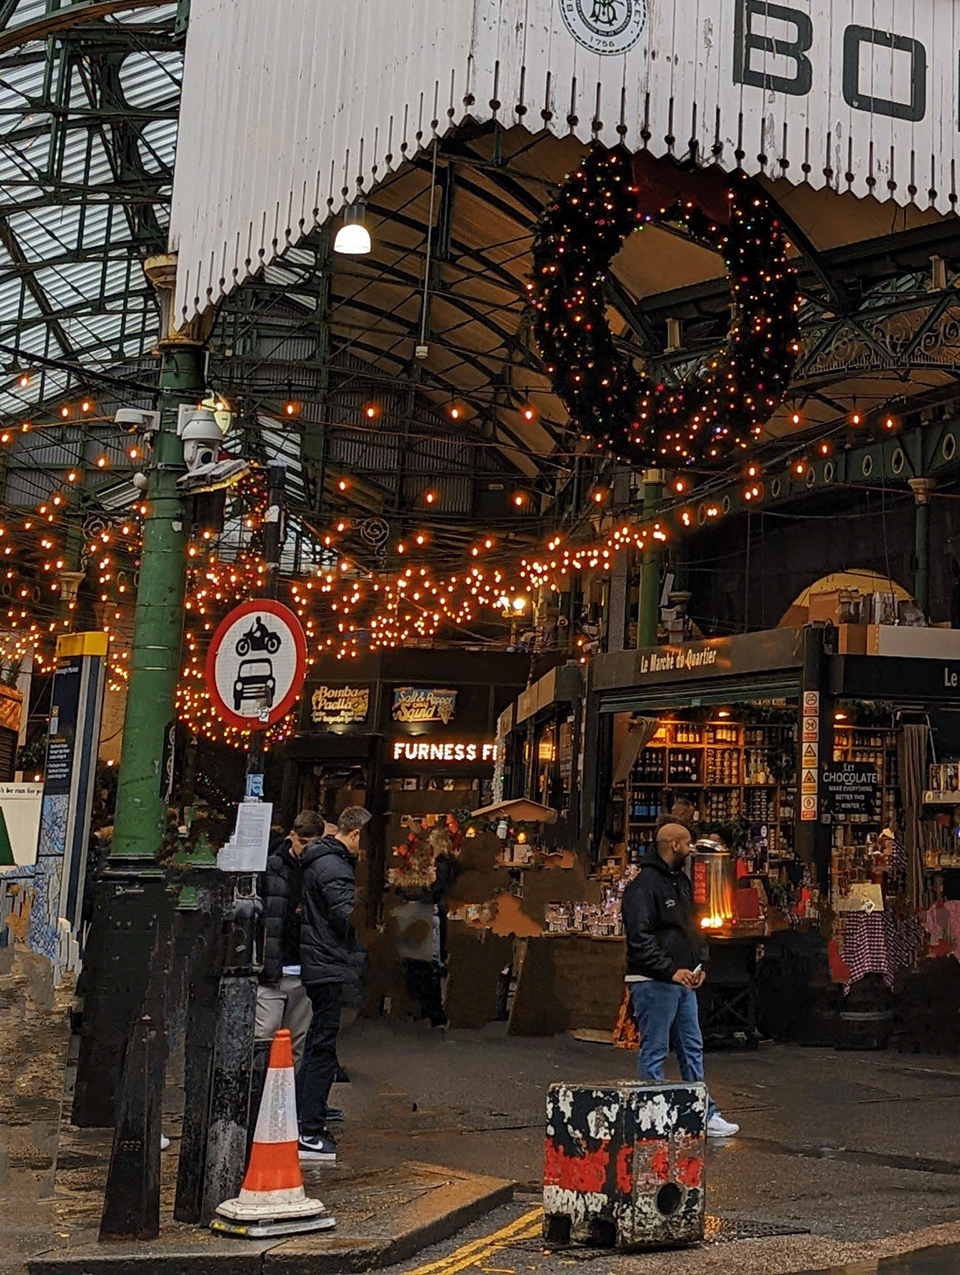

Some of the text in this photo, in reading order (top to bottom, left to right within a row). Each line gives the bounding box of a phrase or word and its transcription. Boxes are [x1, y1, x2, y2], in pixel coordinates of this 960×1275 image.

[590, 36, 615, 47] 1756
[640, 646, 717, 674] Le Marché du Quartier
[944, 668, 958, 687] Le
[394, 743, 477, 761] FURNESS
[823, 772, 877, 783] CHOCOLATE
